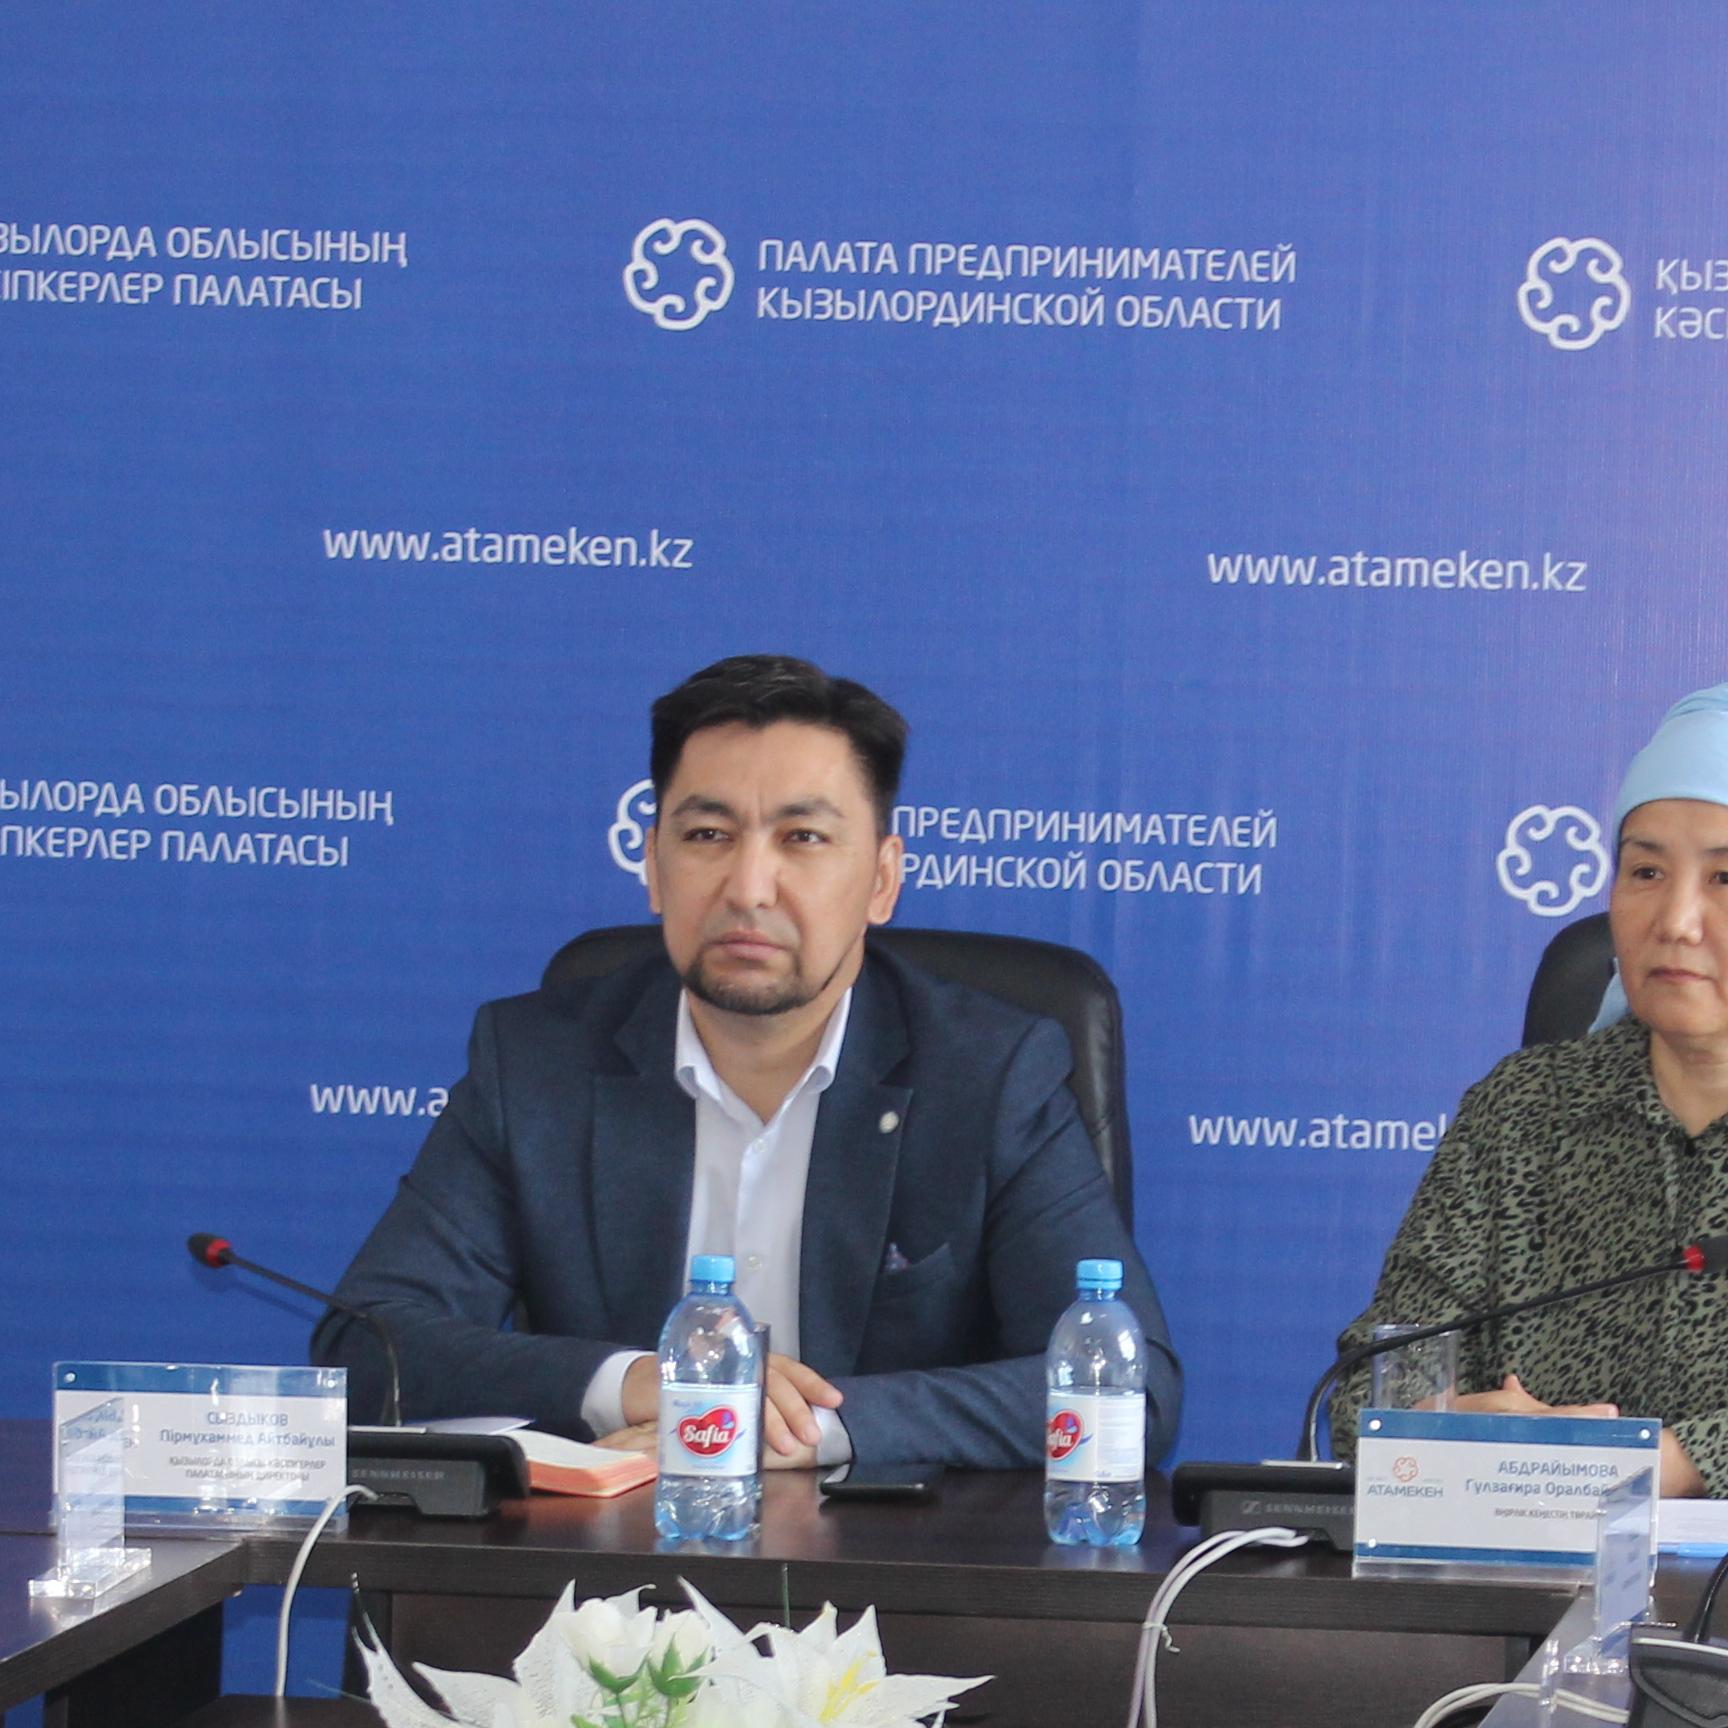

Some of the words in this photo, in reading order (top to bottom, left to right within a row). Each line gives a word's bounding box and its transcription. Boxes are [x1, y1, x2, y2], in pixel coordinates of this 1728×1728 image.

[166, 227, 407, 268] ОБЛЫСЫНЫҢ
[757, 238, 899, 274] ПАЛАТА
[907, 242, 1297, 283] ПРЕДПРИНИМАТЕЛЕЙ
[171, 273, 362, 310] ПАЛАТАСЫ
[755, 286, 1105, 328] КЫЗЫЛОРДИНСКОЙ
[1115, 295, 1282, 330] ОБЛАСТИ
[321, 526, 694, 568] www.atameken.kz
[1206, 550, 1588, 591] www.atameken.kz
[154, 784, 394, 826] ОБЛЫСЫНЫҢ
[893, 806, 1276, 847] ПРЕДПРИНИМАТЕЛЕЙ
[160, 830, 349, 867] ПАЛАТАСЫ
[901, 852, 1087, 890] РДИНСКОЙ
[1097, 860, 1263, 895] ОБЛАСТИ
[1187, 1112, 1448, 1152] www.atame
[683, 1424, 729, 1448] Safia
[1498, 1460, 1619, 1478] АБДРАЙЫМОВА
